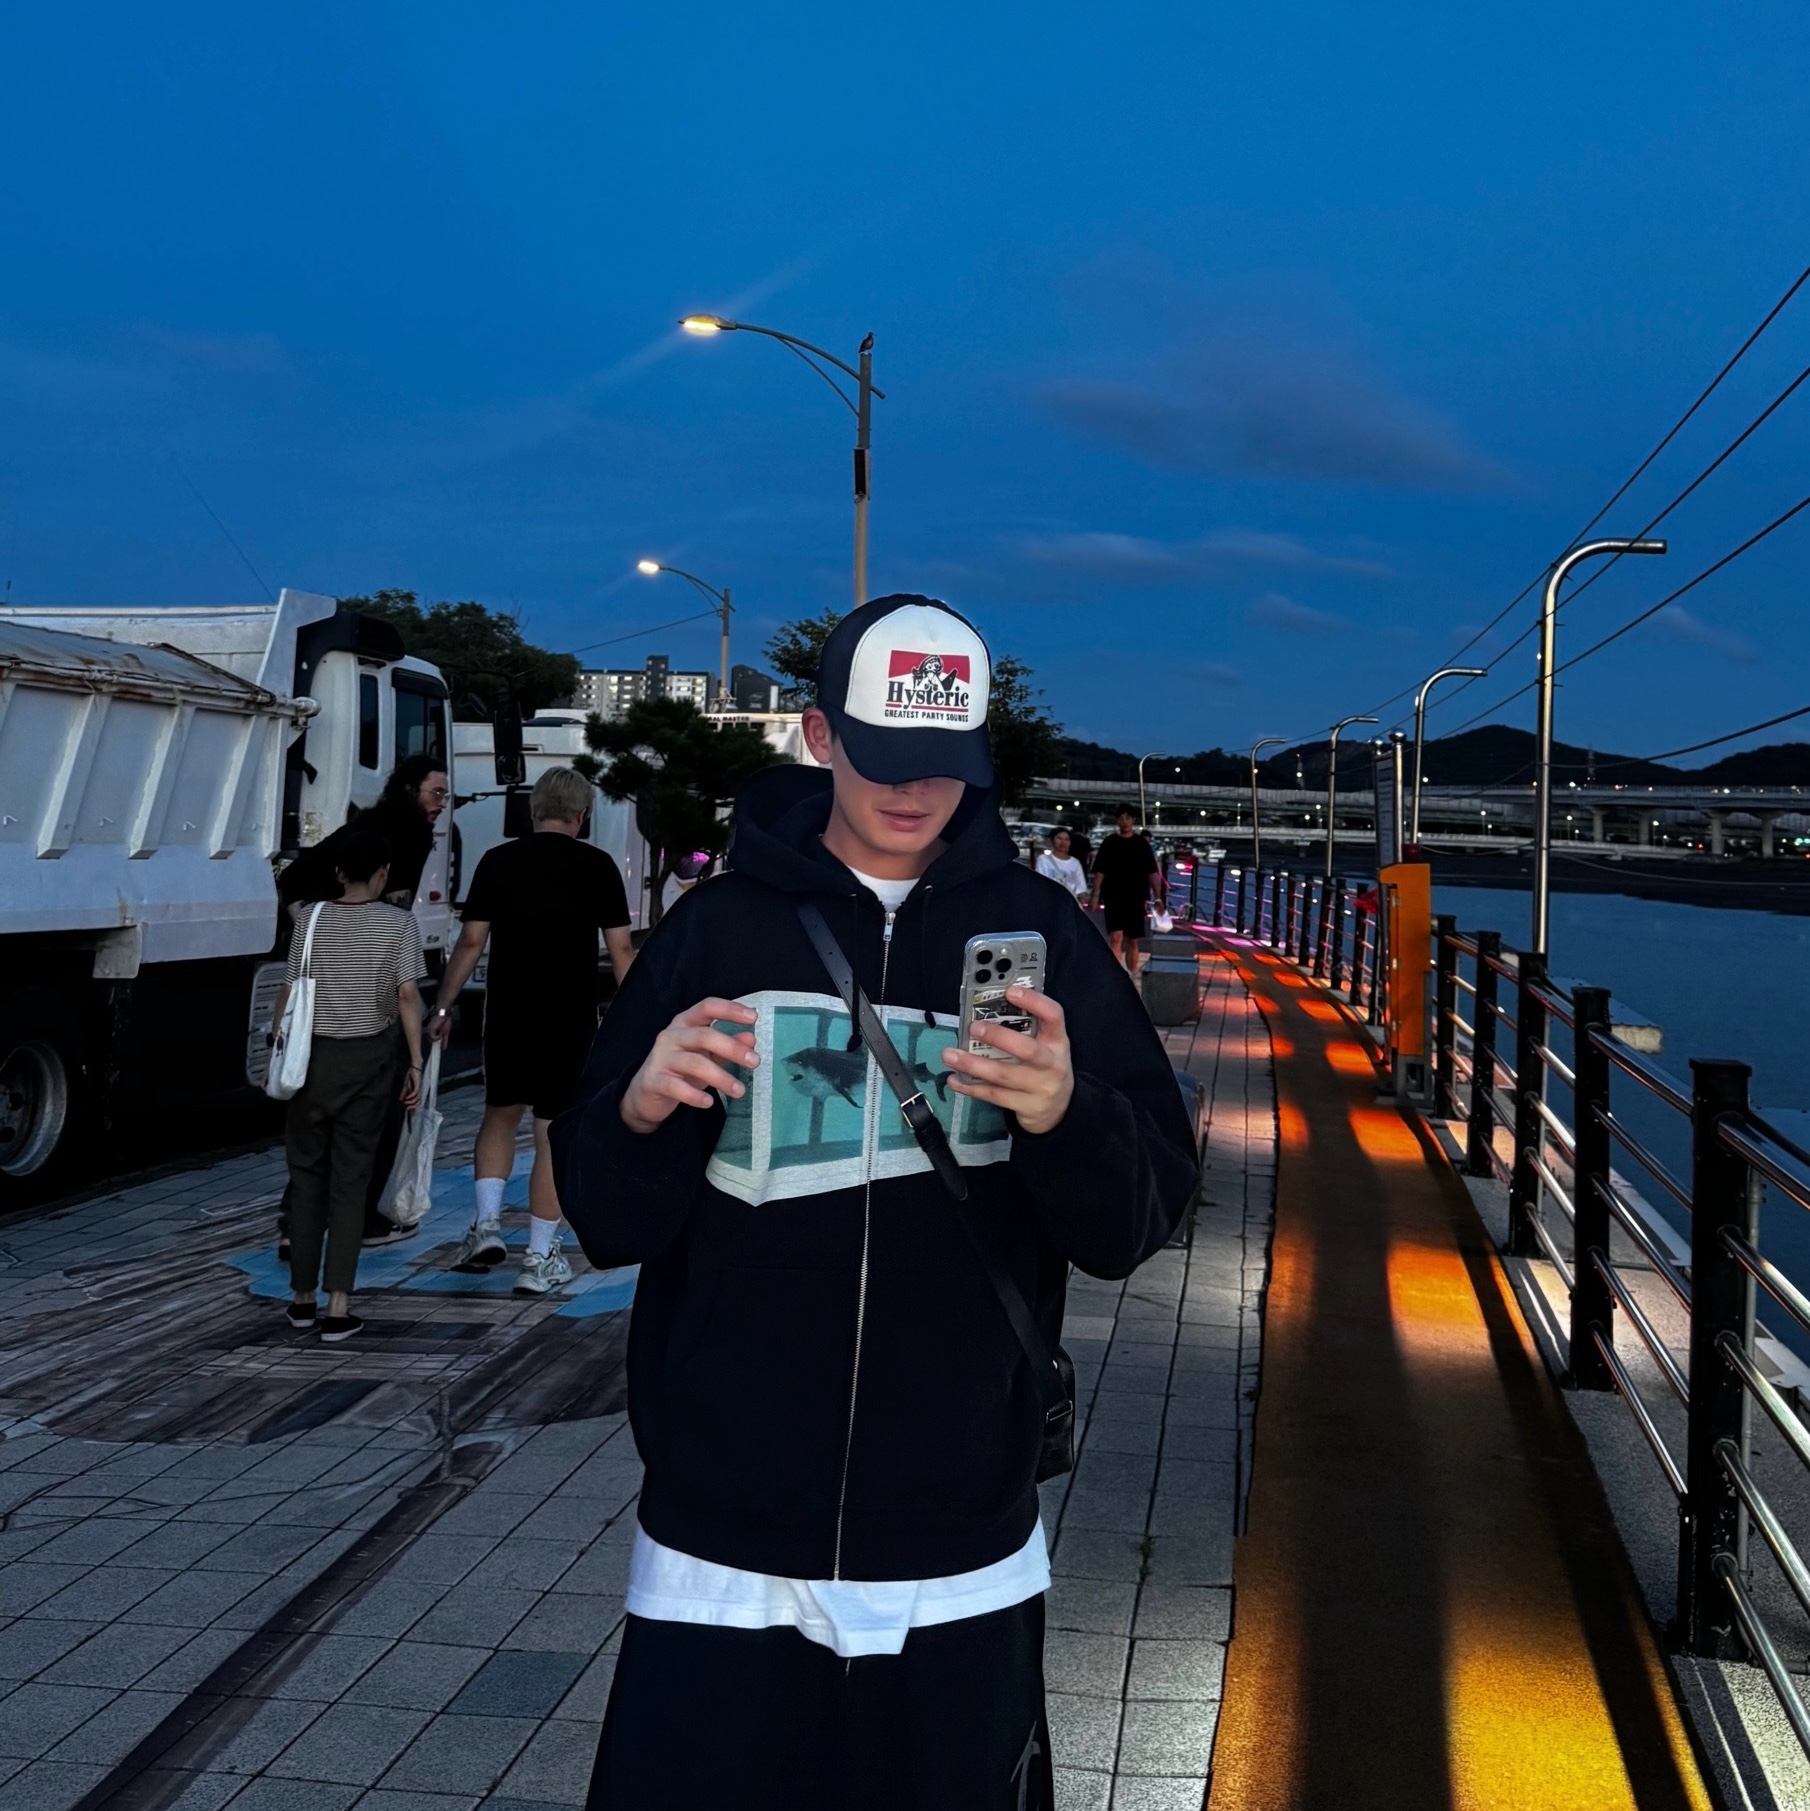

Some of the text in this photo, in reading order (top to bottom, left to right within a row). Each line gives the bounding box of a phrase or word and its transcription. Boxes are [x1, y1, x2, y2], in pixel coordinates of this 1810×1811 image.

[886, 680, 969, 709] Hysteric
[884, 709, 919, 719] GREATEST
[922, 711, 944, 720] PARTY
